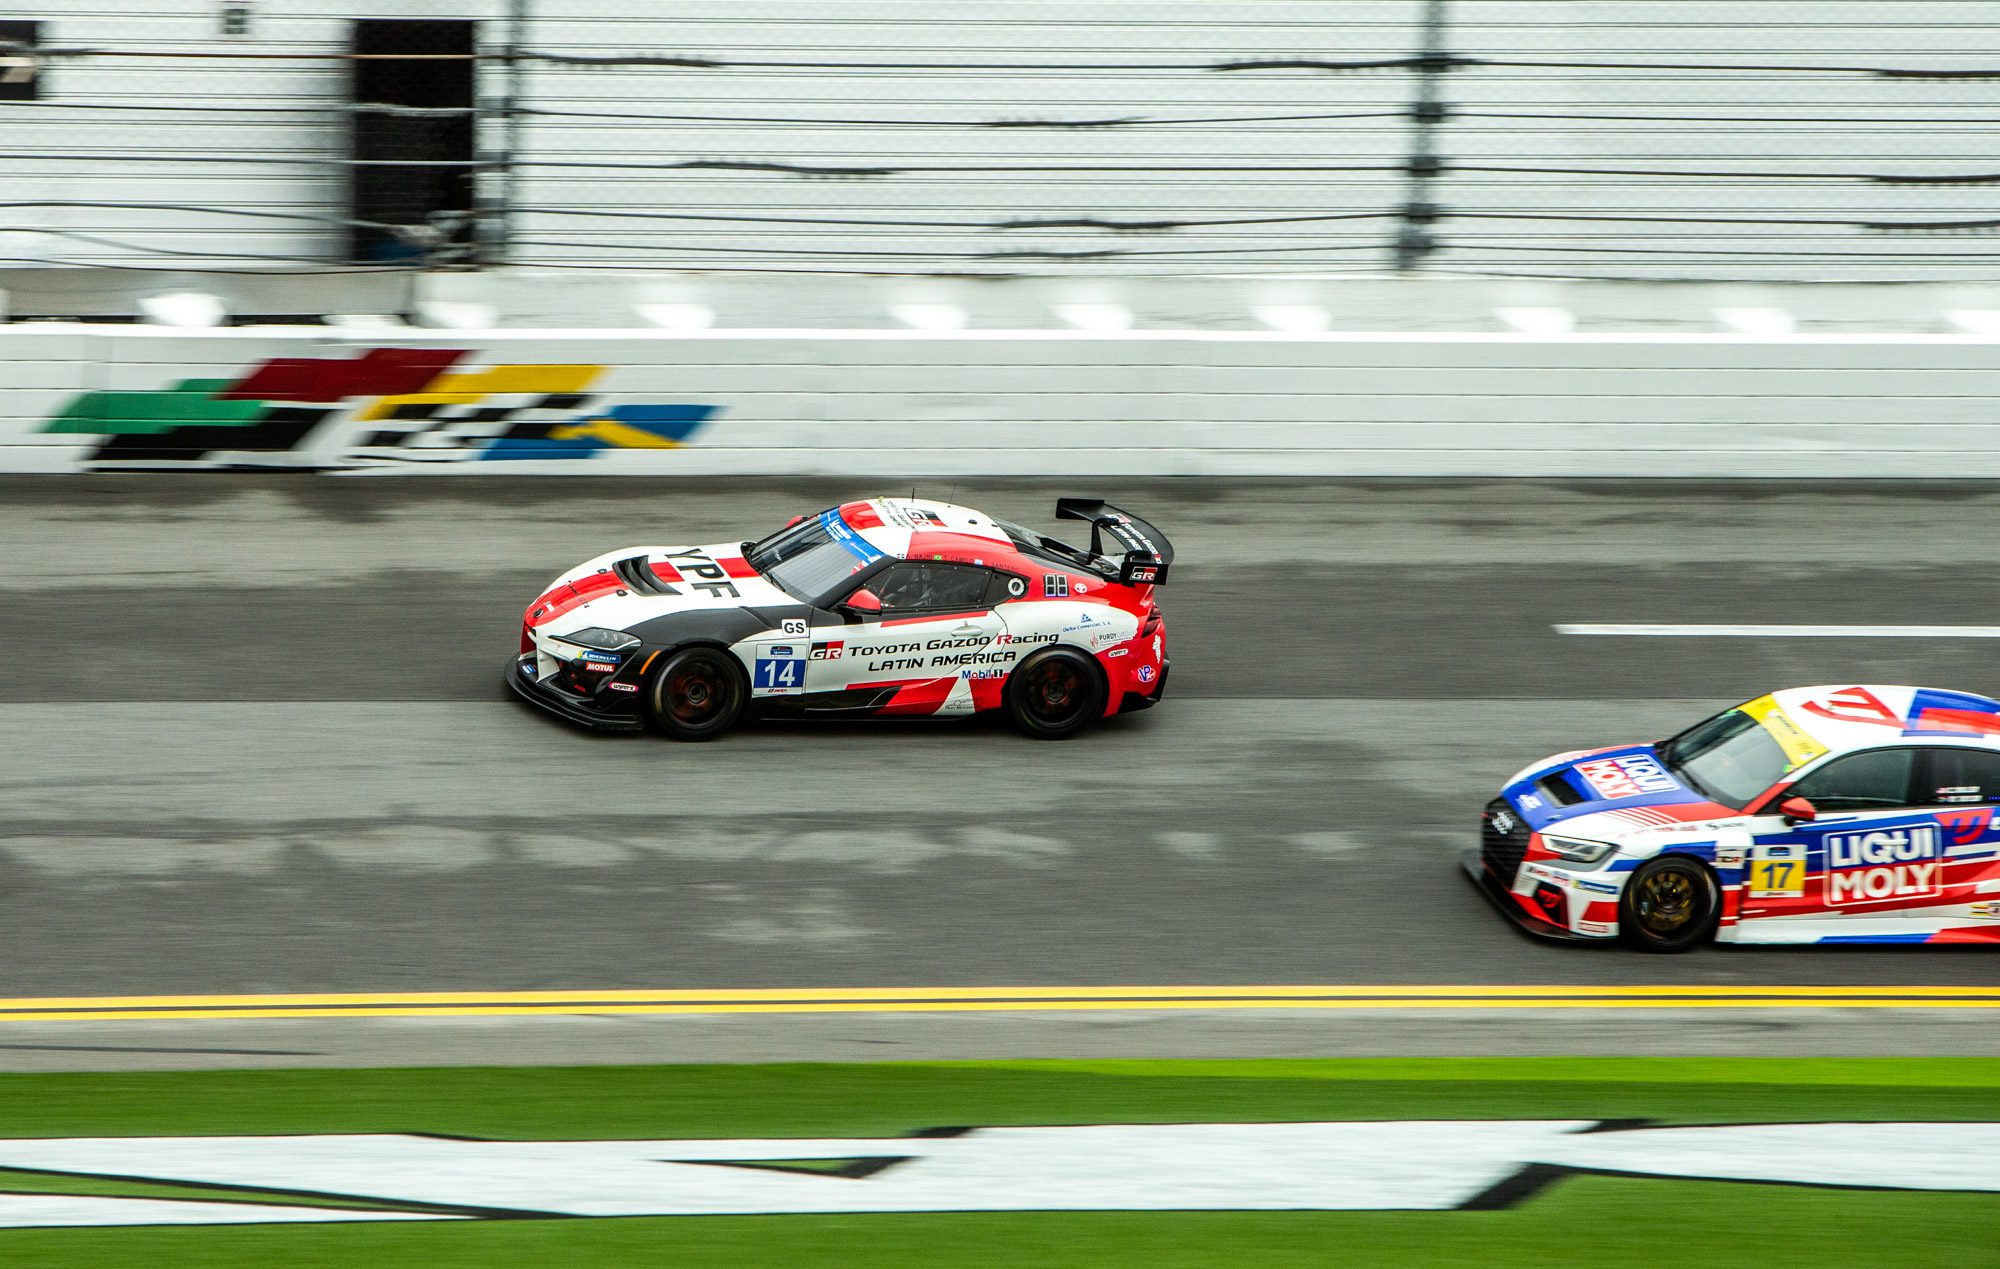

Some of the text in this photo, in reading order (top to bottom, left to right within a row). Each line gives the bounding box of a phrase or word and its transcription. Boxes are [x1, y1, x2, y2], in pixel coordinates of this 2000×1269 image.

[664, 548, 741, 598] YPF
[784, 622, 804, 634] GS
[810, 647, 843, 660] GR
[849, 633, 1059, 656] TOYOTA GAZOO Racing
[587, 664, 613, 672] MOTUL
[765, 660, 796, 687] 14
[868, 652, 1016, 672] LATIN AMERICA
[962, 669, 991, 680] Mobil
[1580, 760, 1643, 798] MOLY
[1613, 755, 1677, 792] LIQUI
[1830, 828, 1935, 867] LIQUI
[1761, 863, 1795, 888] 17
[1830, 864, 1936, 901] MOLY
